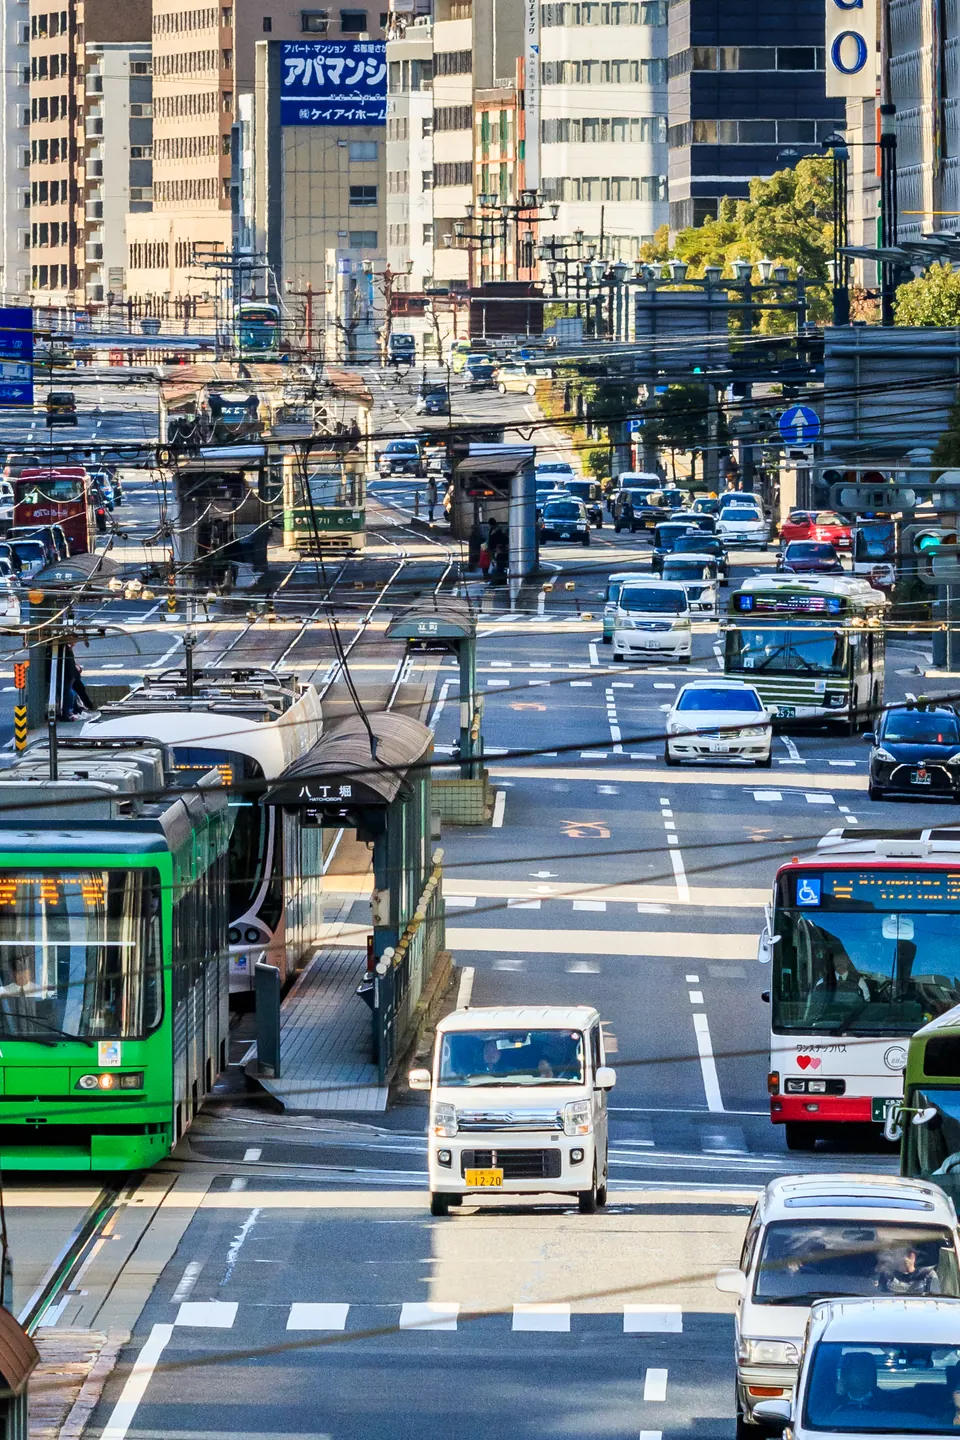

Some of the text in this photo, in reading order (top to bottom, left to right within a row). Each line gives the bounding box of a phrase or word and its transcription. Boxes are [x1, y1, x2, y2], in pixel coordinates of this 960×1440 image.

[284, 45, 346, 53] アパート・マンション
[284, 56, 387, 85] アパマンシ
[418, 622, 438, 630] 立町
[299, 785, 352, 797] 八丁堀
[796, 1044, 847, 1053] ワンステップバス
[475, 1177, 501, 1186] 12-20
